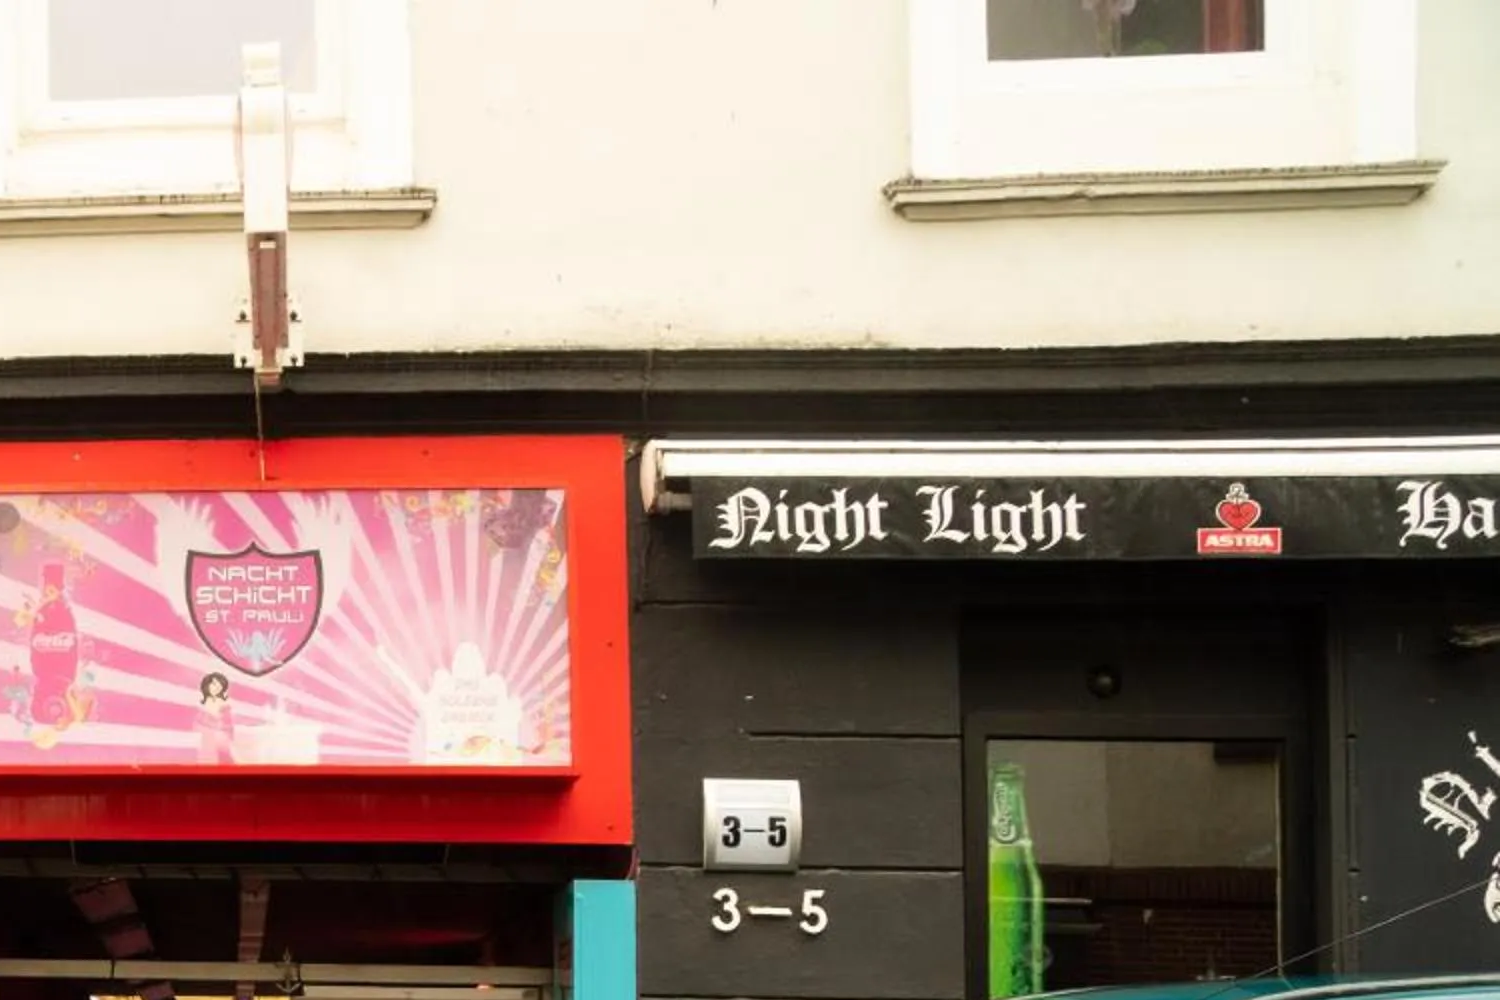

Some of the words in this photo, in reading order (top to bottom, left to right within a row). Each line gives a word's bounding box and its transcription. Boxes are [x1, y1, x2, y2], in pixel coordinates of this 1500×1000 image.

[708, 487, 888, 553] Night
[916, 485, 1087, 553] Light
[1204, 533, 1274, 548] ASTRA
[208, 565, 299, 582] NACHT
[205, 609, 232, 623] ST
